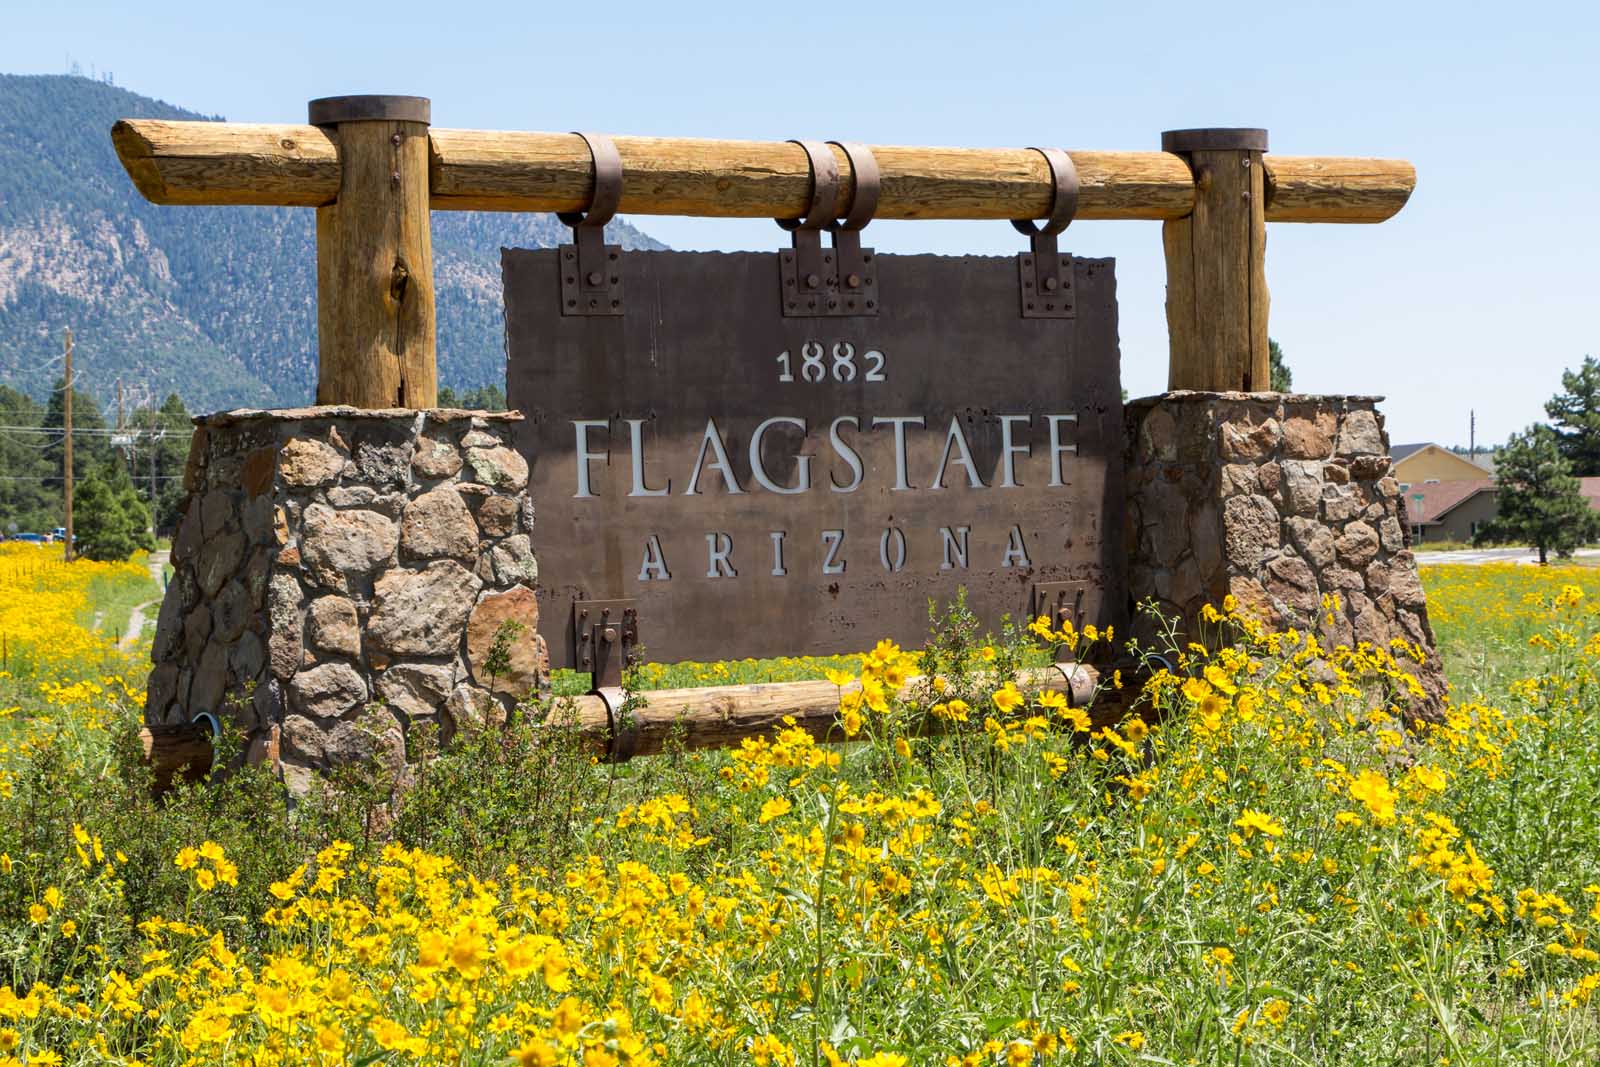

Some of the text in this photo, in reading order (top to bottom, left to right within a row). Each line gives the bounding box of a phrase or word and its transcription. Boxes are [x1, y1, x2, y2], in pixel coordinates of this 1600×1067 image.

[776, 342, 887, 383] 1882
[571, 415, 1078, 498] FLAGSTAFF
[637, 525, 1032, 581] ARIZONA
